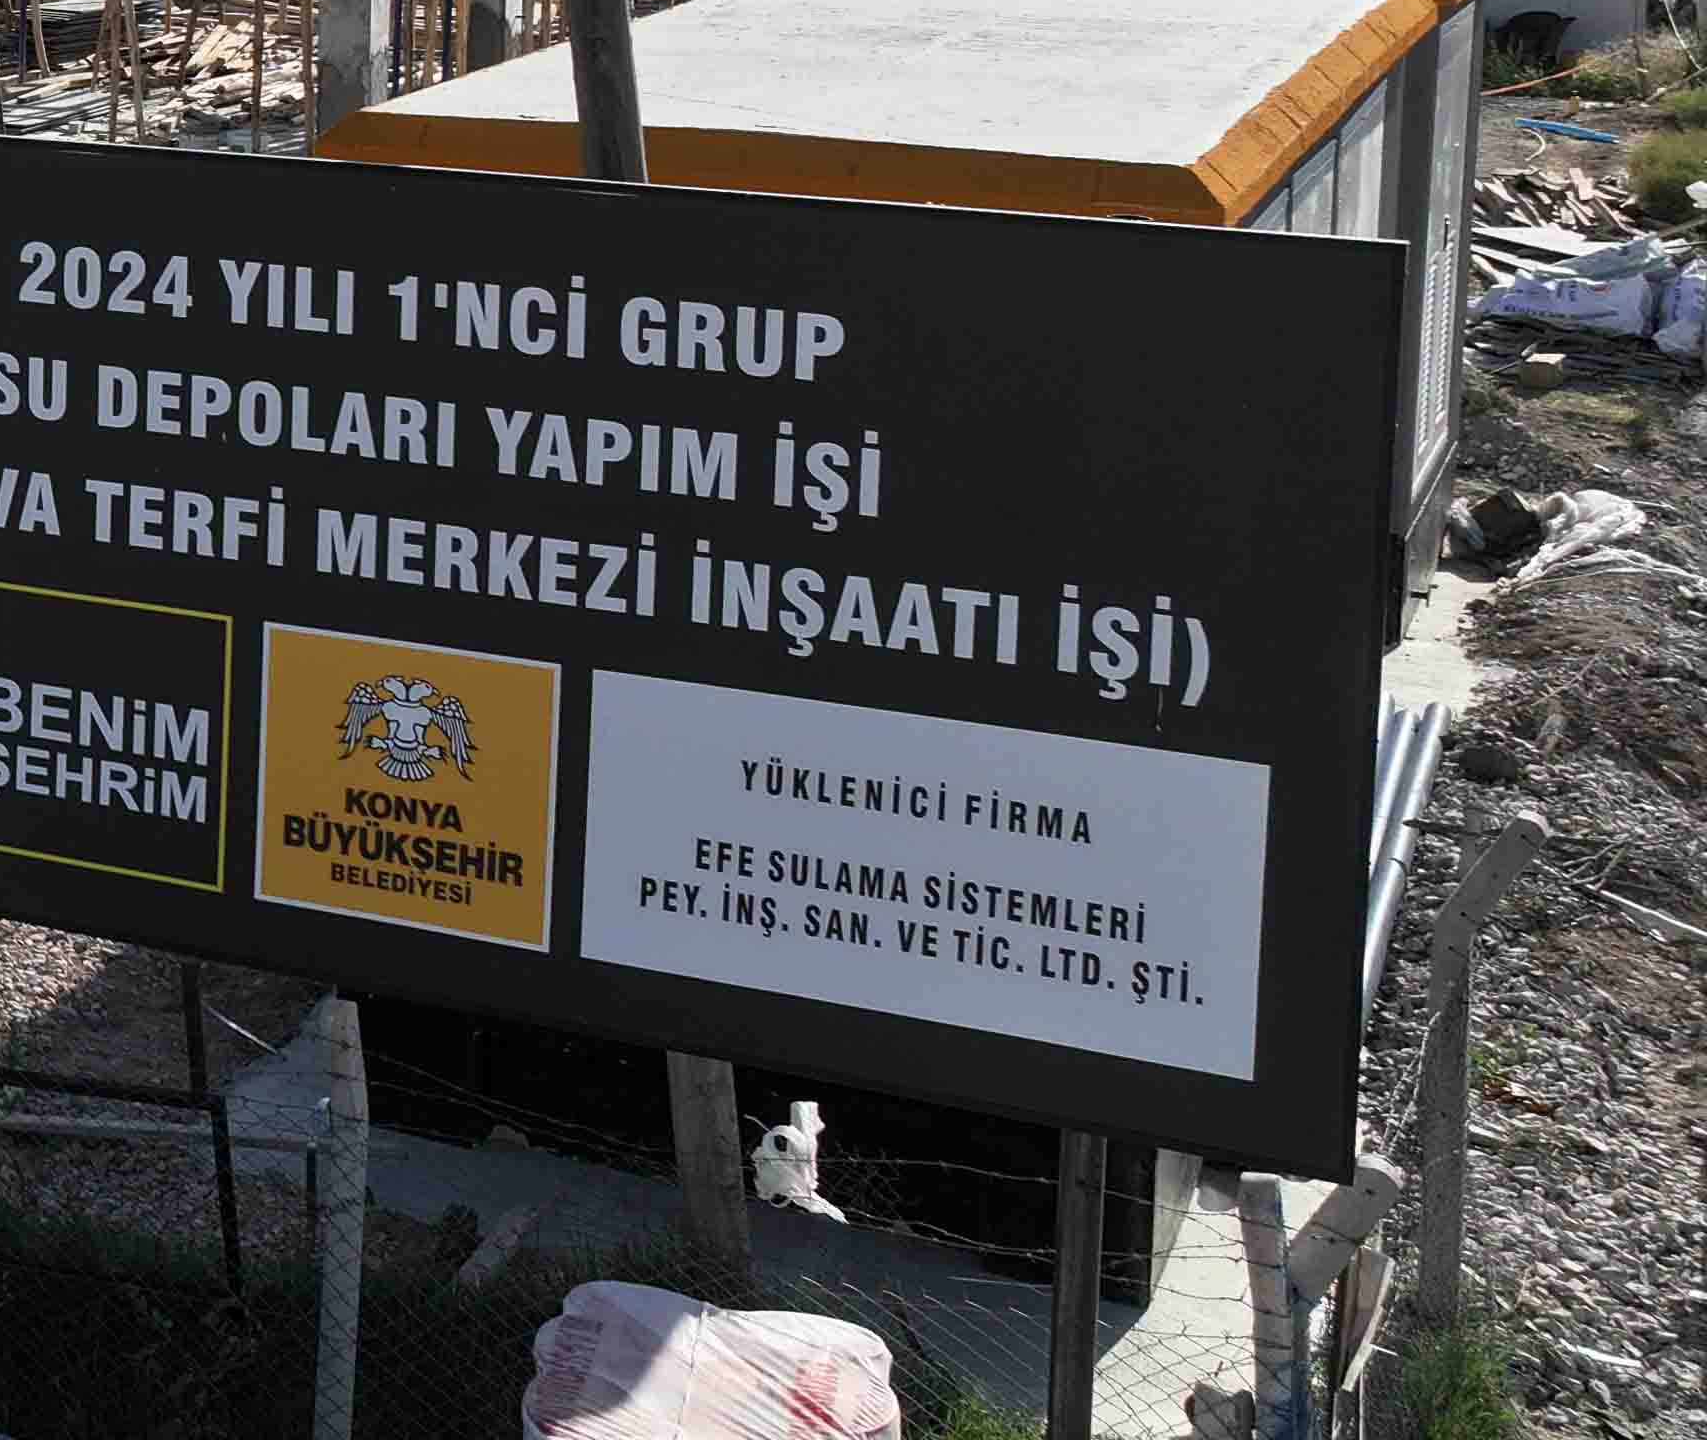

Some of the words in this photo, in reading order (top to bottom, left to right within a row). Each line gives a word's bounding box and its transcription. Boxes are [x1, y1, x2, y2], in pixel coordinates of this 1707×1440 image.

[20, 242, 192, 317] 2024
[219, 260, 353, 334] YILI
[389, 276, 585, 358] 1'NCİ
[622, 298, 843, 380] GRUP
[99, 366, 455, 466] DEPOLARI
[486, 408, 737, 500] YAPIM
[774, 422, 880, 533] İŞİ
[86, 480, 284, 565] TERFİ
[318, 509, 655, 616] MERKEZİ
[692, 540, 1018, 664] İNŞAATI
[1058, 584, 1208, 705] İŞİ)
[283, 811, 524, 888] BÜYÜKŞEHİR
[344, 787, 464, 833] KONYA
[740, 756, 947, 822] YÜKLENİCİ
[965, 790, 1091, 844] FİRMA
[330, 862, 472, 906] BELEDİYESİ
[695, 838, 756, 879] EFE
[766, 850, 910, 903] SULAMA
[921, 872, 1146, 945] SİSTEMLERİ
[639, 875, 707, 918] PEY.
[722, 889, 790, 938] İNŞ.
[803, 904, 883, 947] SAN.
[897, 919, 941, 955] VE
[951, 925, 1026, 972] TİC.
[1039, 944, 1117, 988] LTD.
[1132, 960, 1205, 1008] ŞTİ.
